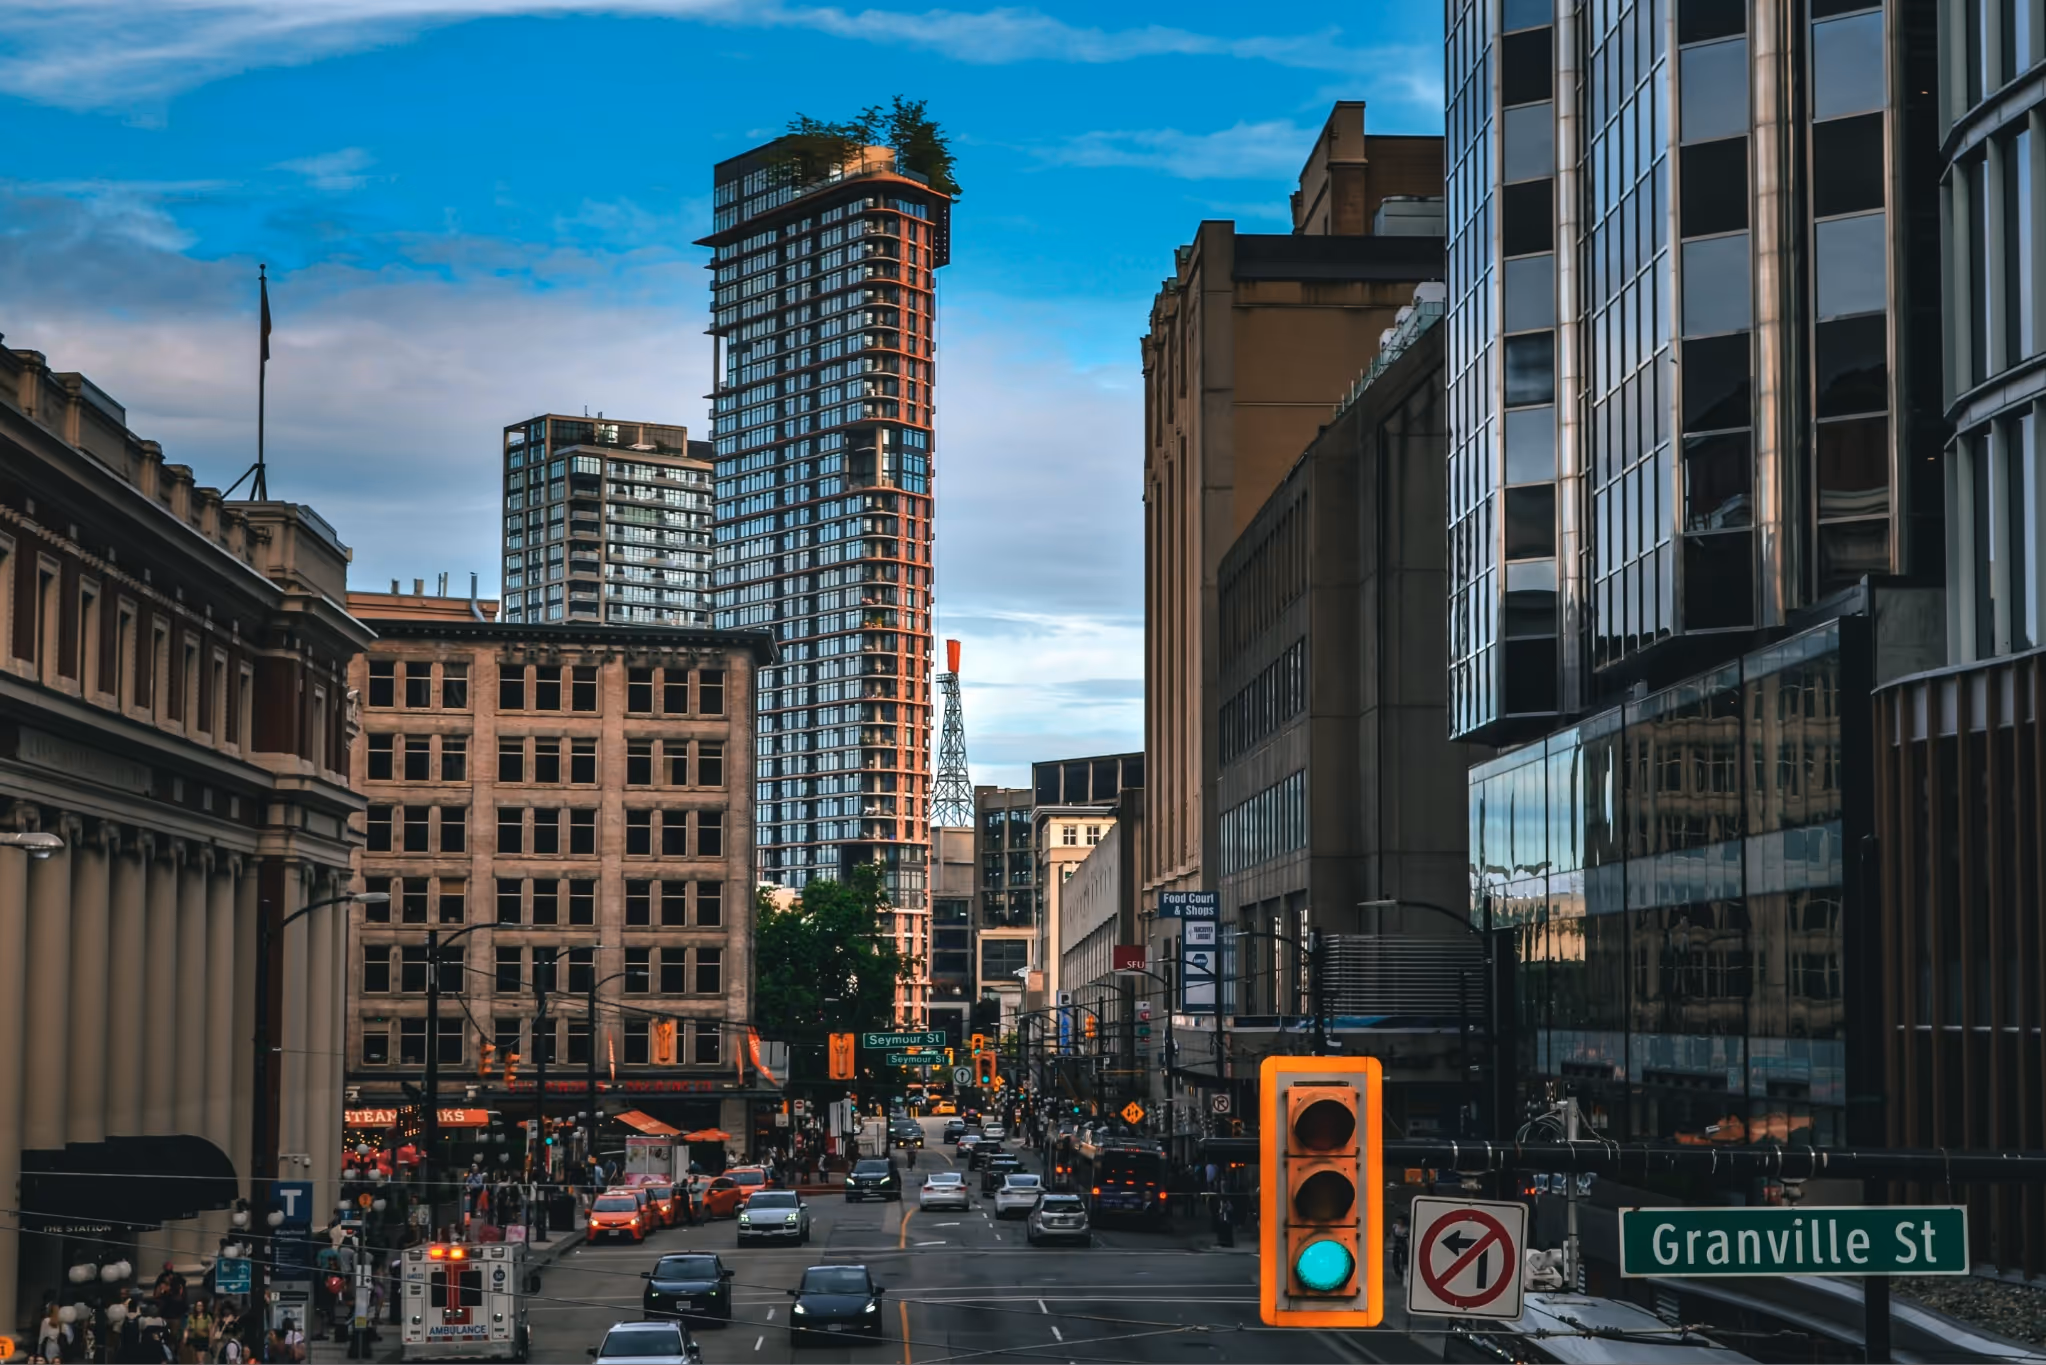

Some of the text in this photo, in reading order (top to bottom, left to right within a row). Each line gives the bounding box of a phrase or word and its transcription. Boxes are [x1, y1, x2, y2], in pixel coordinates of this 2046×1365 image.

[1163, 893, 1214, 904] Food Court
[1174, 905, 1214, 916] & Shops
[1127, 961, 1145, 969] SFU
[869, 1033, 940, 1046] Seymour St
[891, 1055, 945, 1064] Seymour St
[280, 1189, 303, 1216] T
[43, 1224, 112, 1233] THE STATION
[1652, 1218, 1938, 1266] Granville St
[429, 1325, 487, 1335] AMBULANCE
